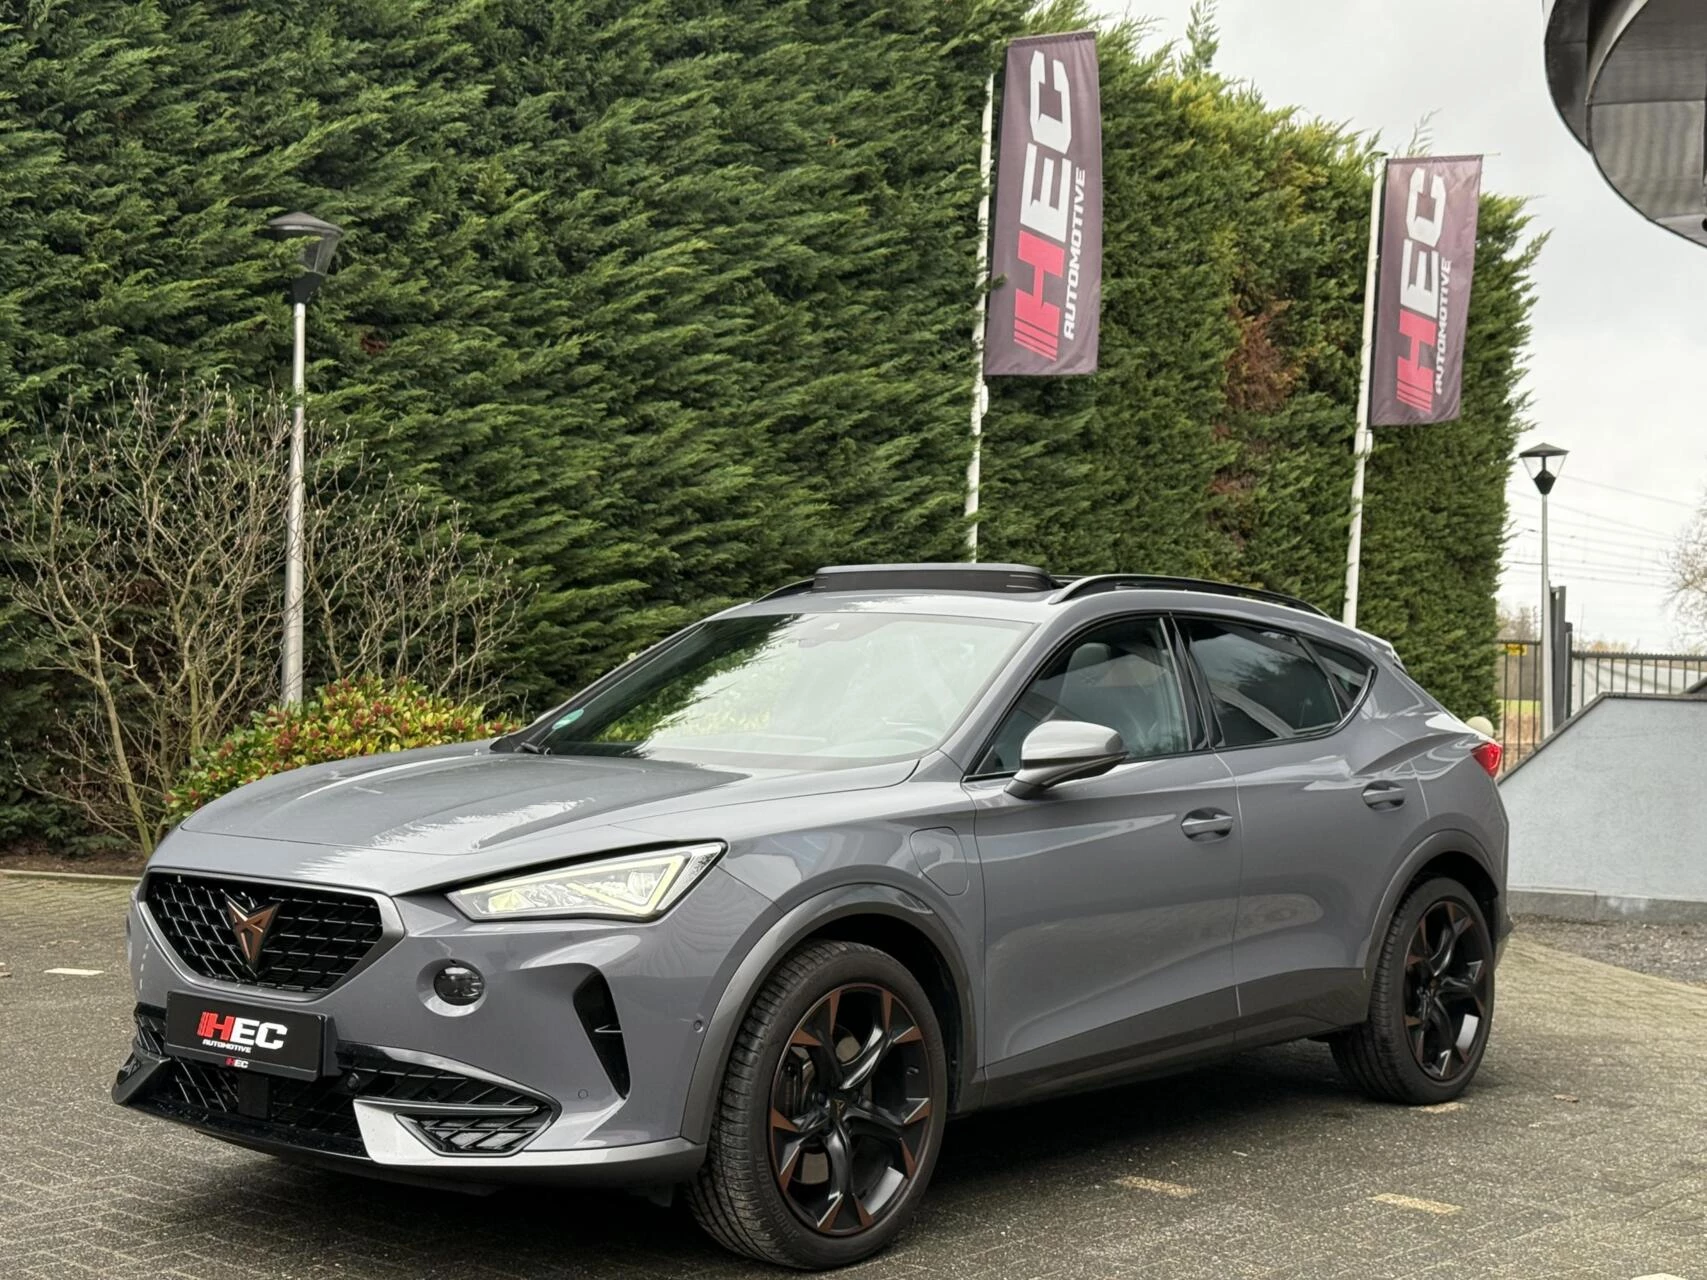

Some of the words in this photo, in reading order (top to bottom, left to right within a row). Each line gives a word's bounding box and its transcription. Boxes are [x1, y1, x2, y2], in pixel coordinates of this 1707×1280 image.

[1013, 50, 1072, 361] HEC
[1064, 166, 1086, 341] AUTOMOTIVE
[1397, 167, 1446, 413] HEC
[1434, 257, 1452, 396] AUTOMOTIVE
[197, 1011, 288, 1050] HEC
[202, 1038, 252, 1054] AUTOMOTIVE
[225, 1057, 249, 1069] HEC
